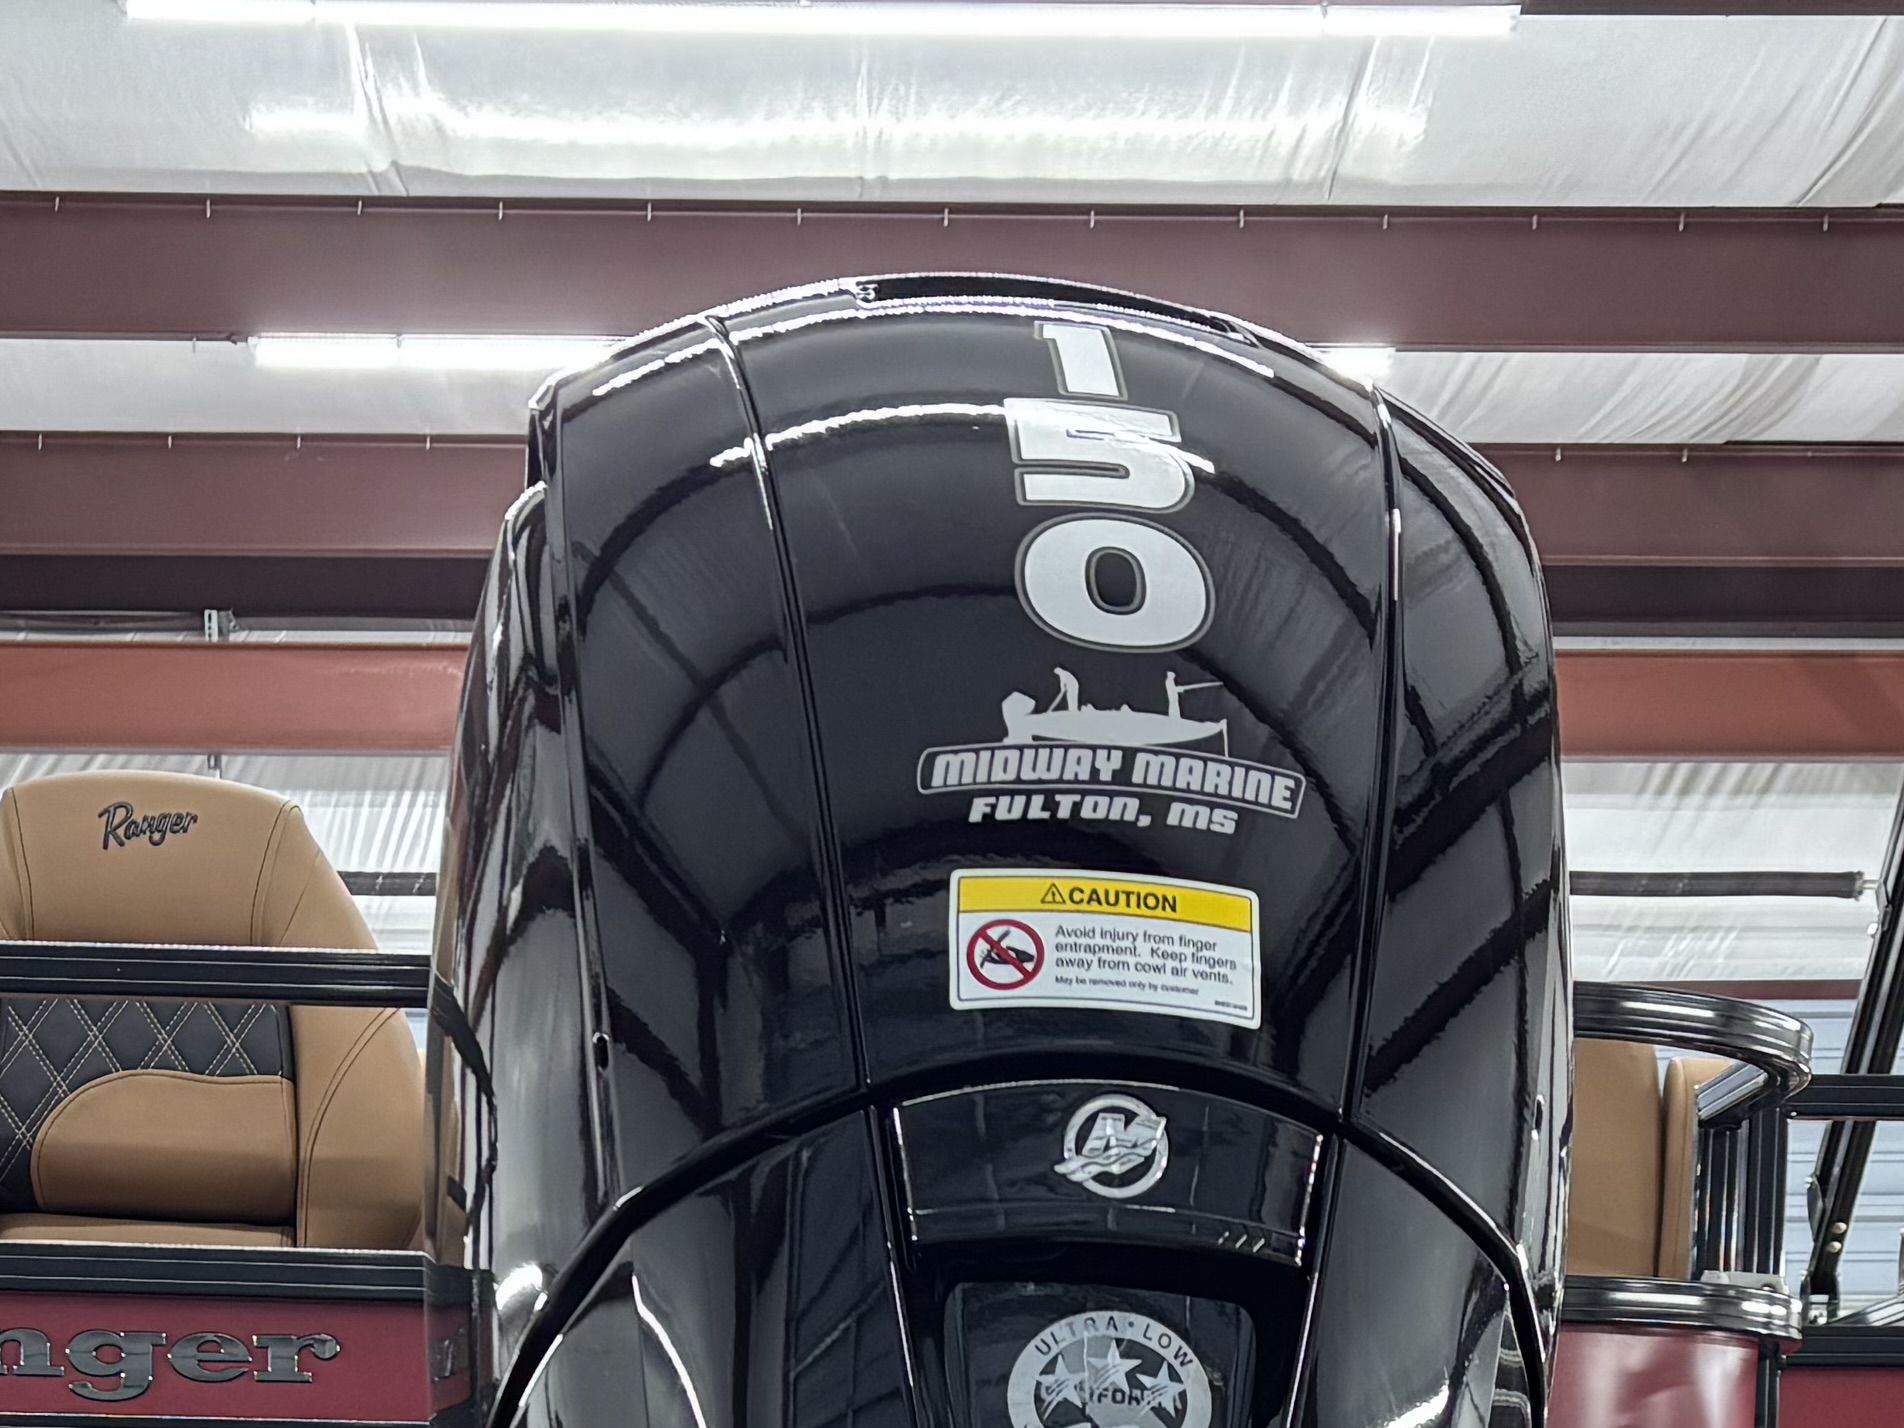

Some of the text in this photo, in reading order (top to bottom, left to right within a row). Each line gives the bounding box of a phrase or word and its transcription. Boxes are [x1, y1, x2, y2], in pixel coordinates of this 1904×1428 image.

[1004, 321, 1215, 653] 150
[931, 747, 1296, 811] MIDWAY MARINE
[97, 801, 199, 851] Ranger
[968, 794, 1239, 835] FULTON, MS
[1068, 886, 1178, 914] CAUTION
[1055, 925, 1217, 954] Avoid injury from finger
[1055, 942, 1237, 971] entrapment. Keep fingers
[1055, 957, 1234, 985] away from cowl air vents.
